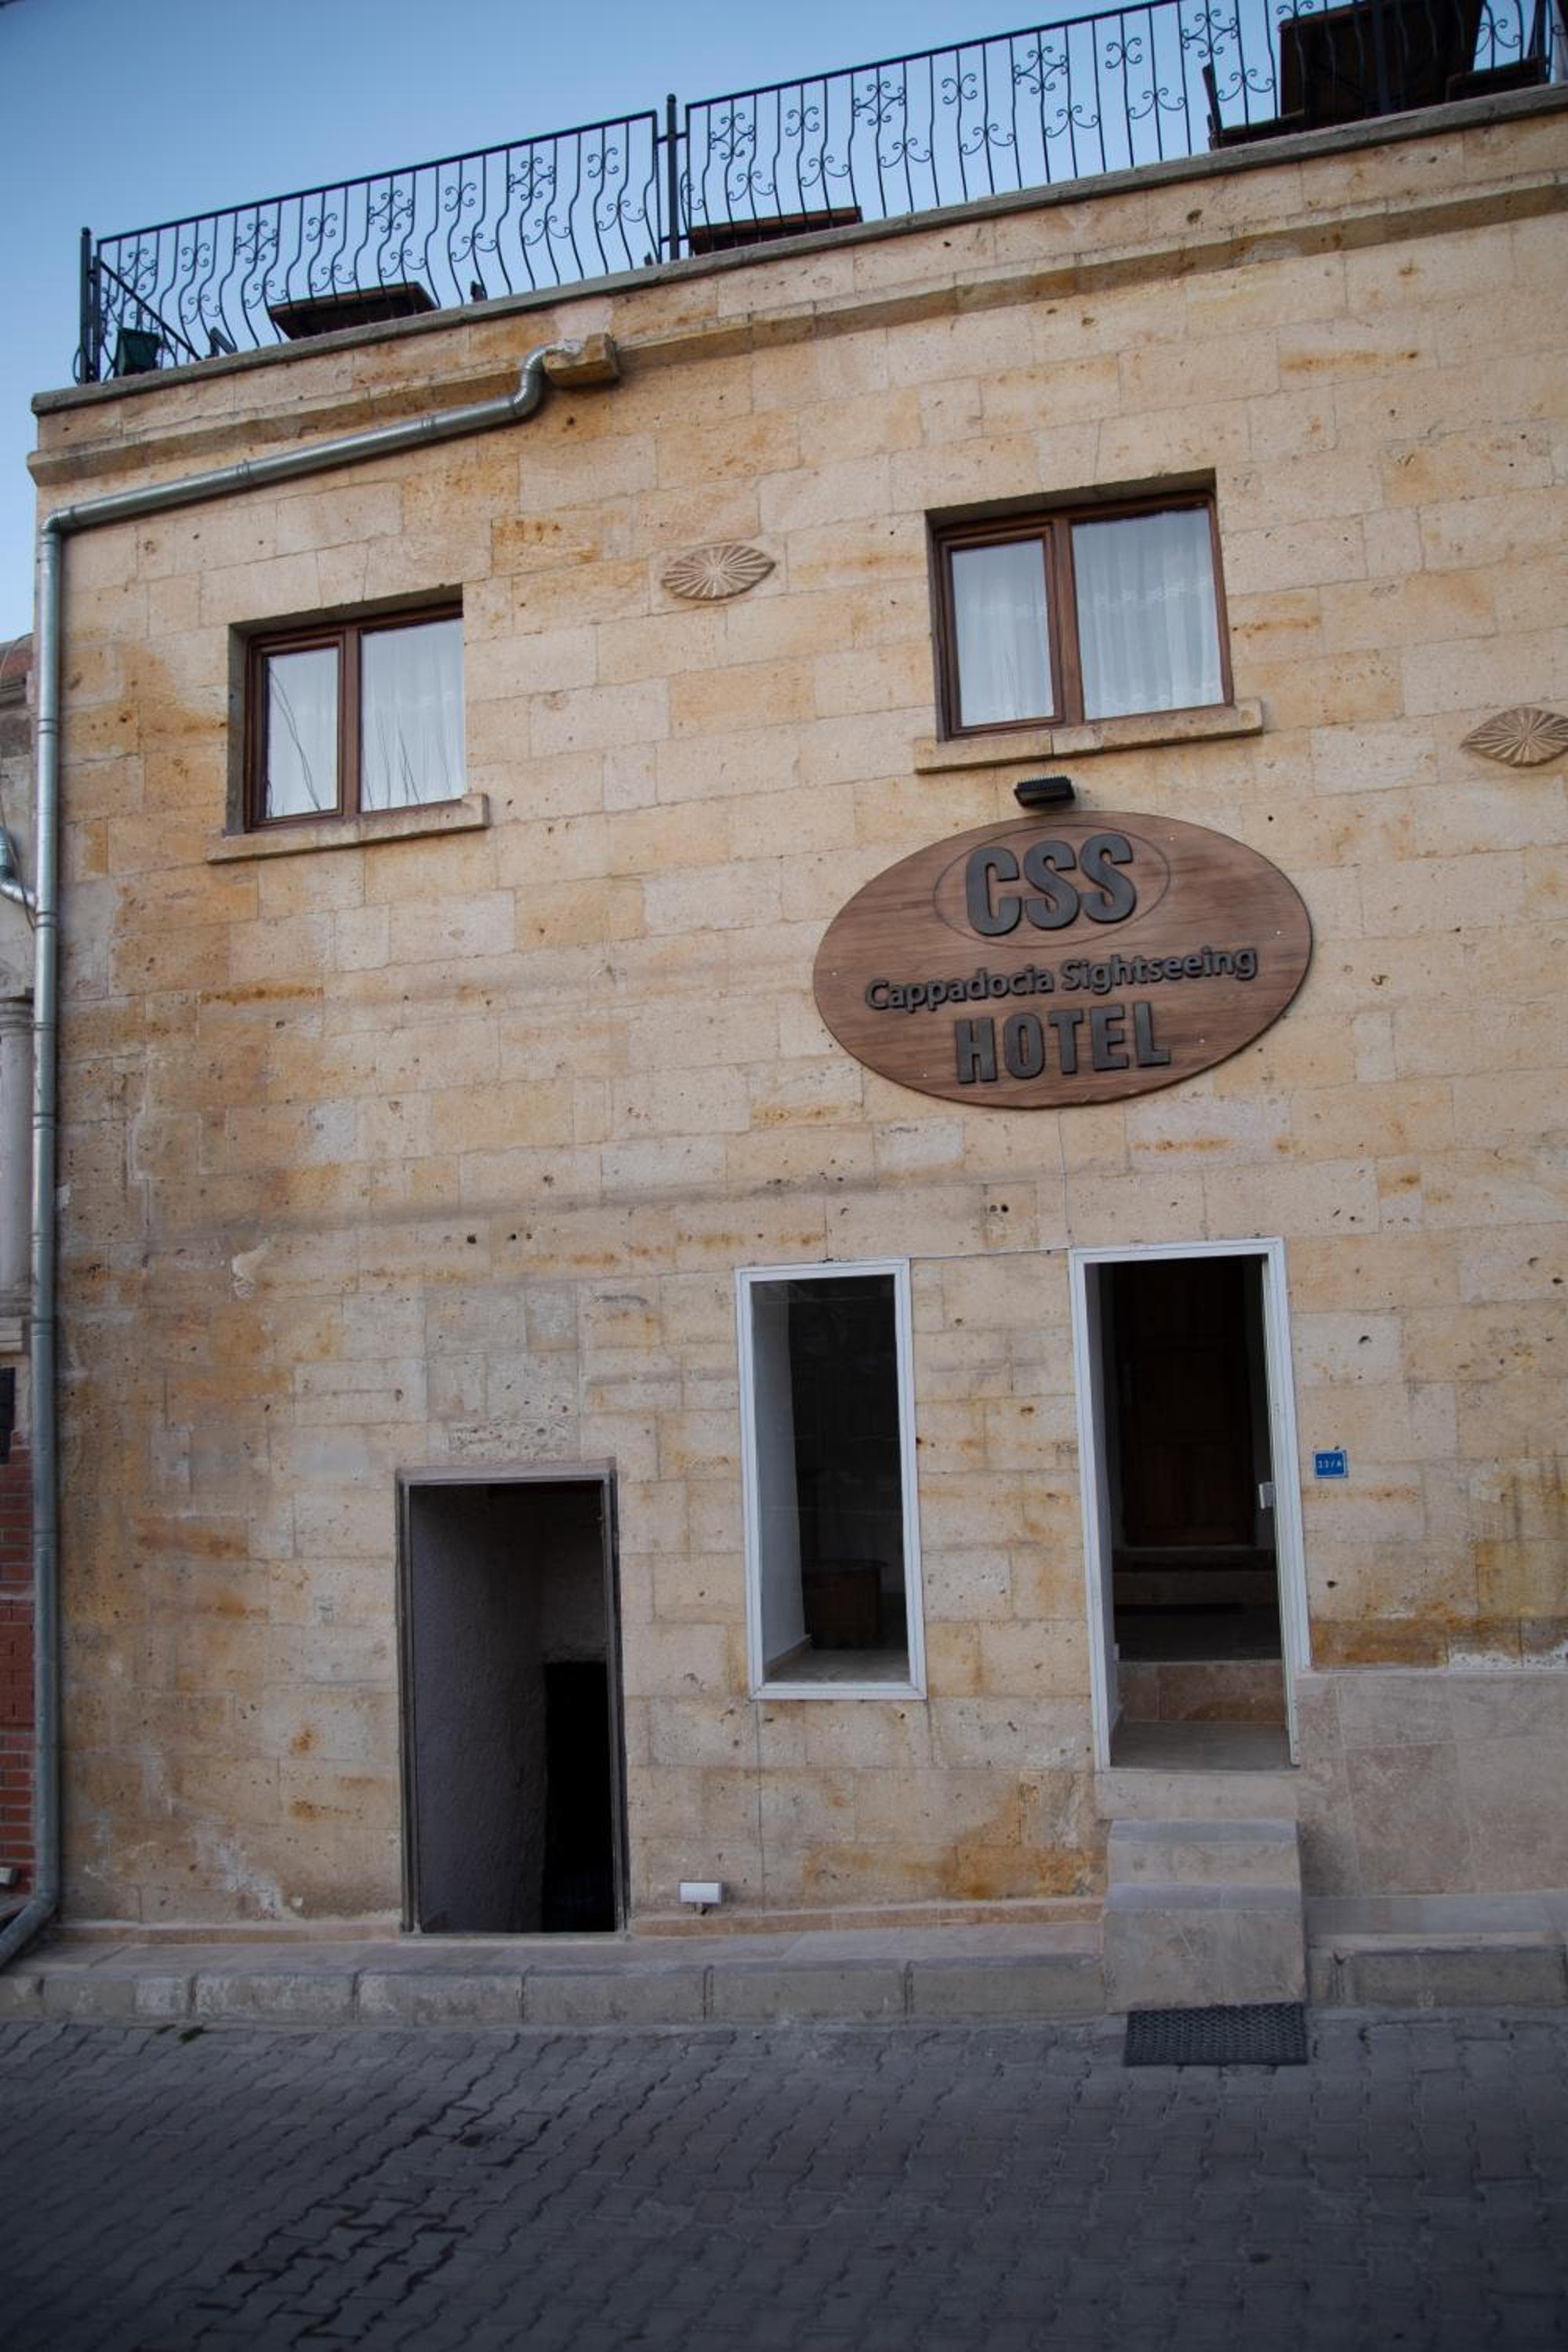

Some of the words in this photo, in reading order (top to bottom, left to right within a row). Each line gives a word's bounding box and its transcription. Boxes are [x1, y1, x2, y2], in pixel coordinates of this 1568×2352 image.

[966, 833, 1137, 935] CSS
[866, 966, 1054, 1012] Cappadocia
[1061, 946, 1258, 995] Sightseeing
[956, 1002, 1171, 1083] HOTEL
